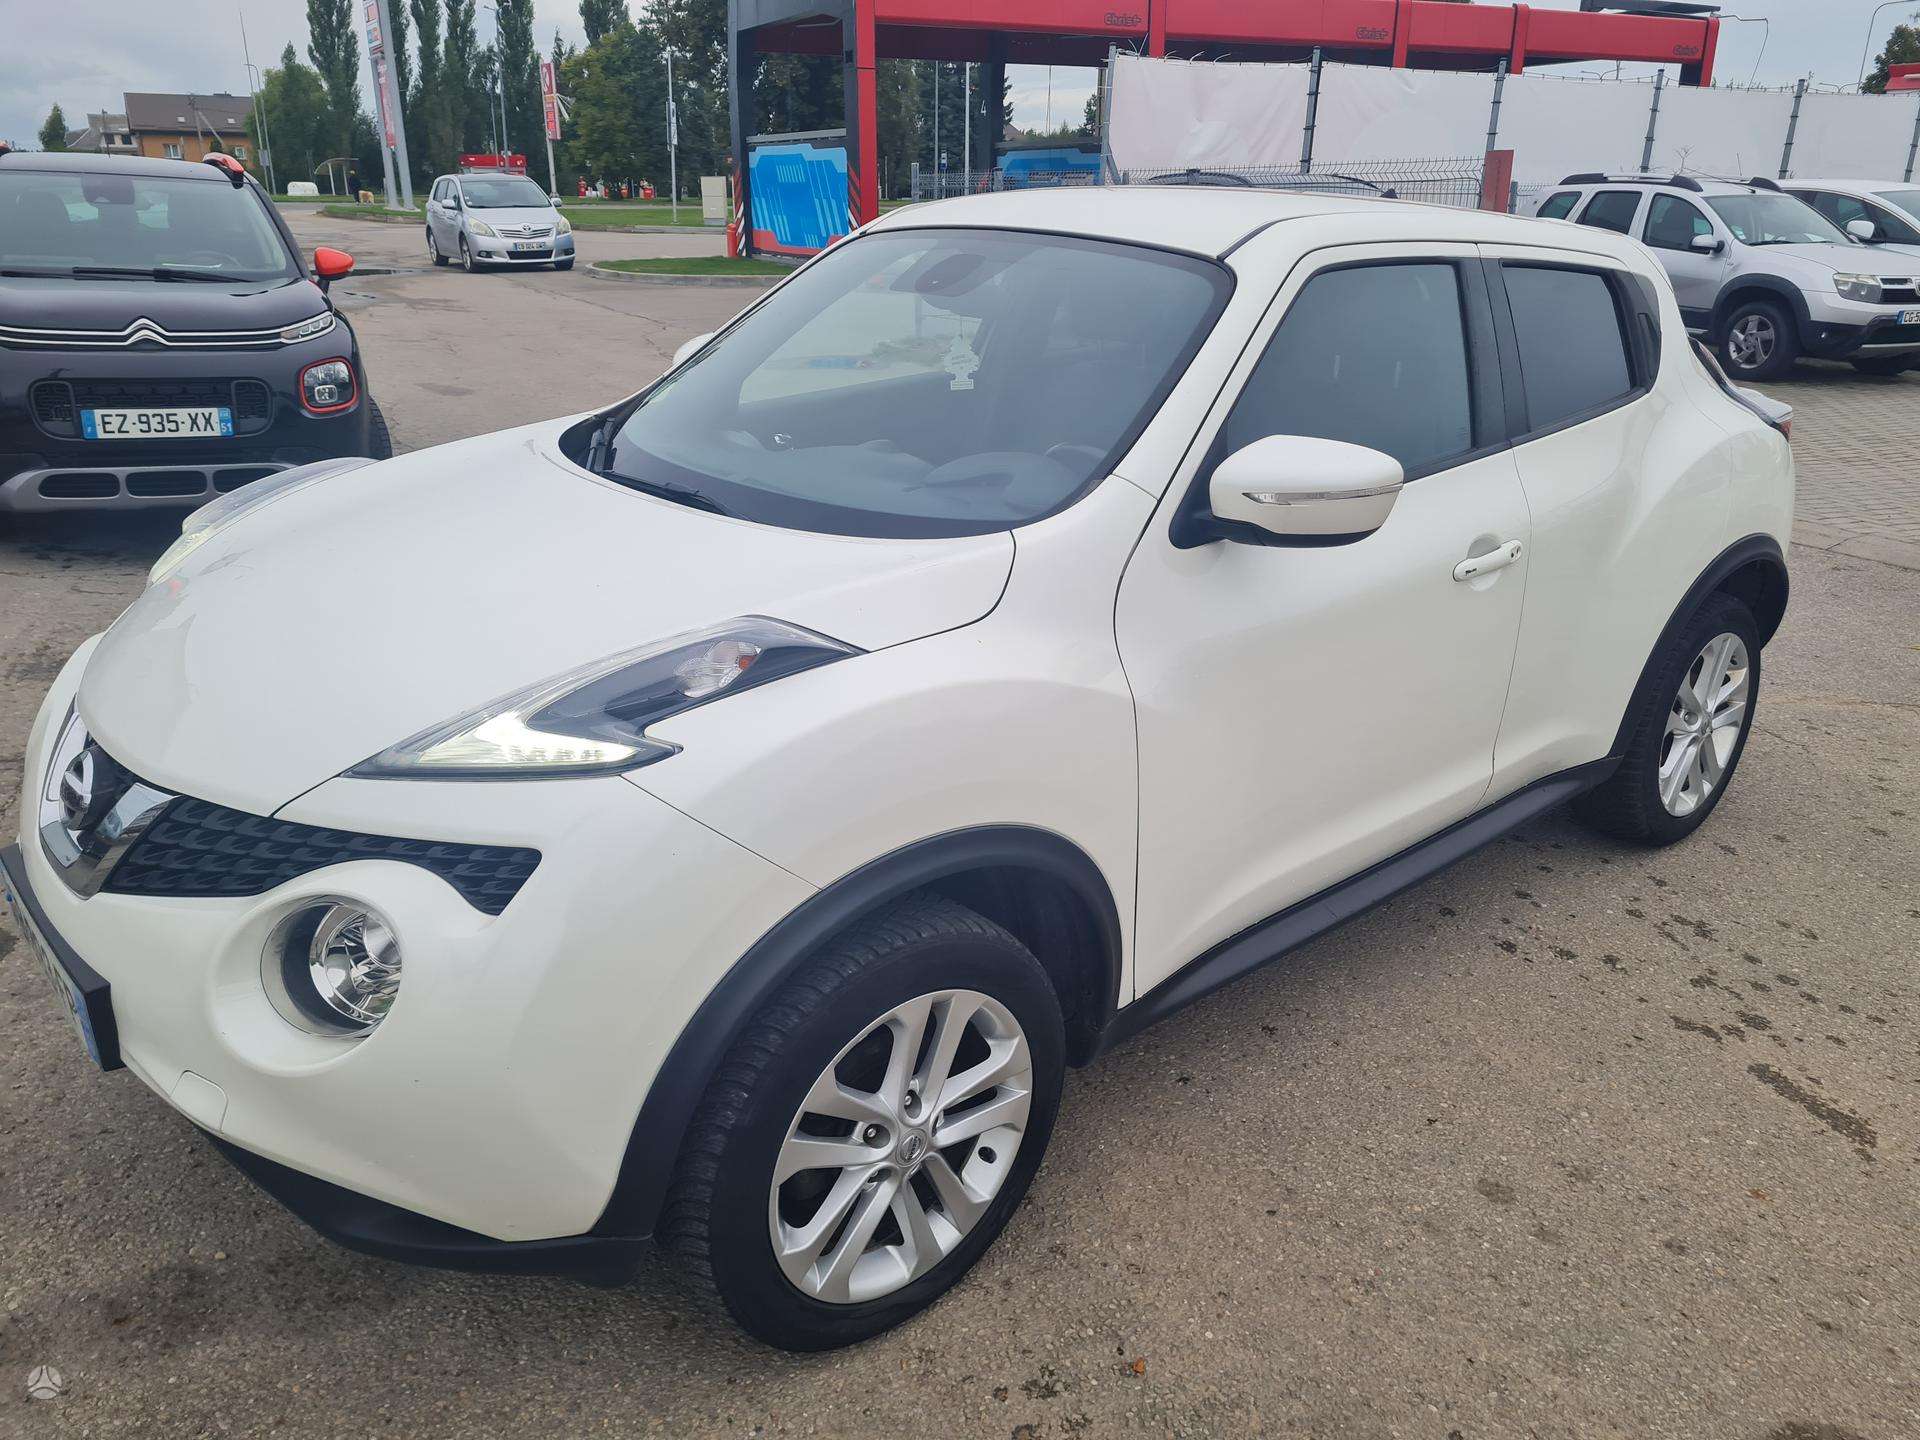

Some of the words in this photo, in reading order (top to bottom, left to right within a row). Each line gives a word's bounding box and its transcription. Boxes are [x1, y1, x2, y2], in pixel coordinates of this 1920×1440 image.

[1104, 12, 1142, 26] Christ
[980, 100, 987, 116] 4
[101, 412, 215, 434] EZ-935-XX
